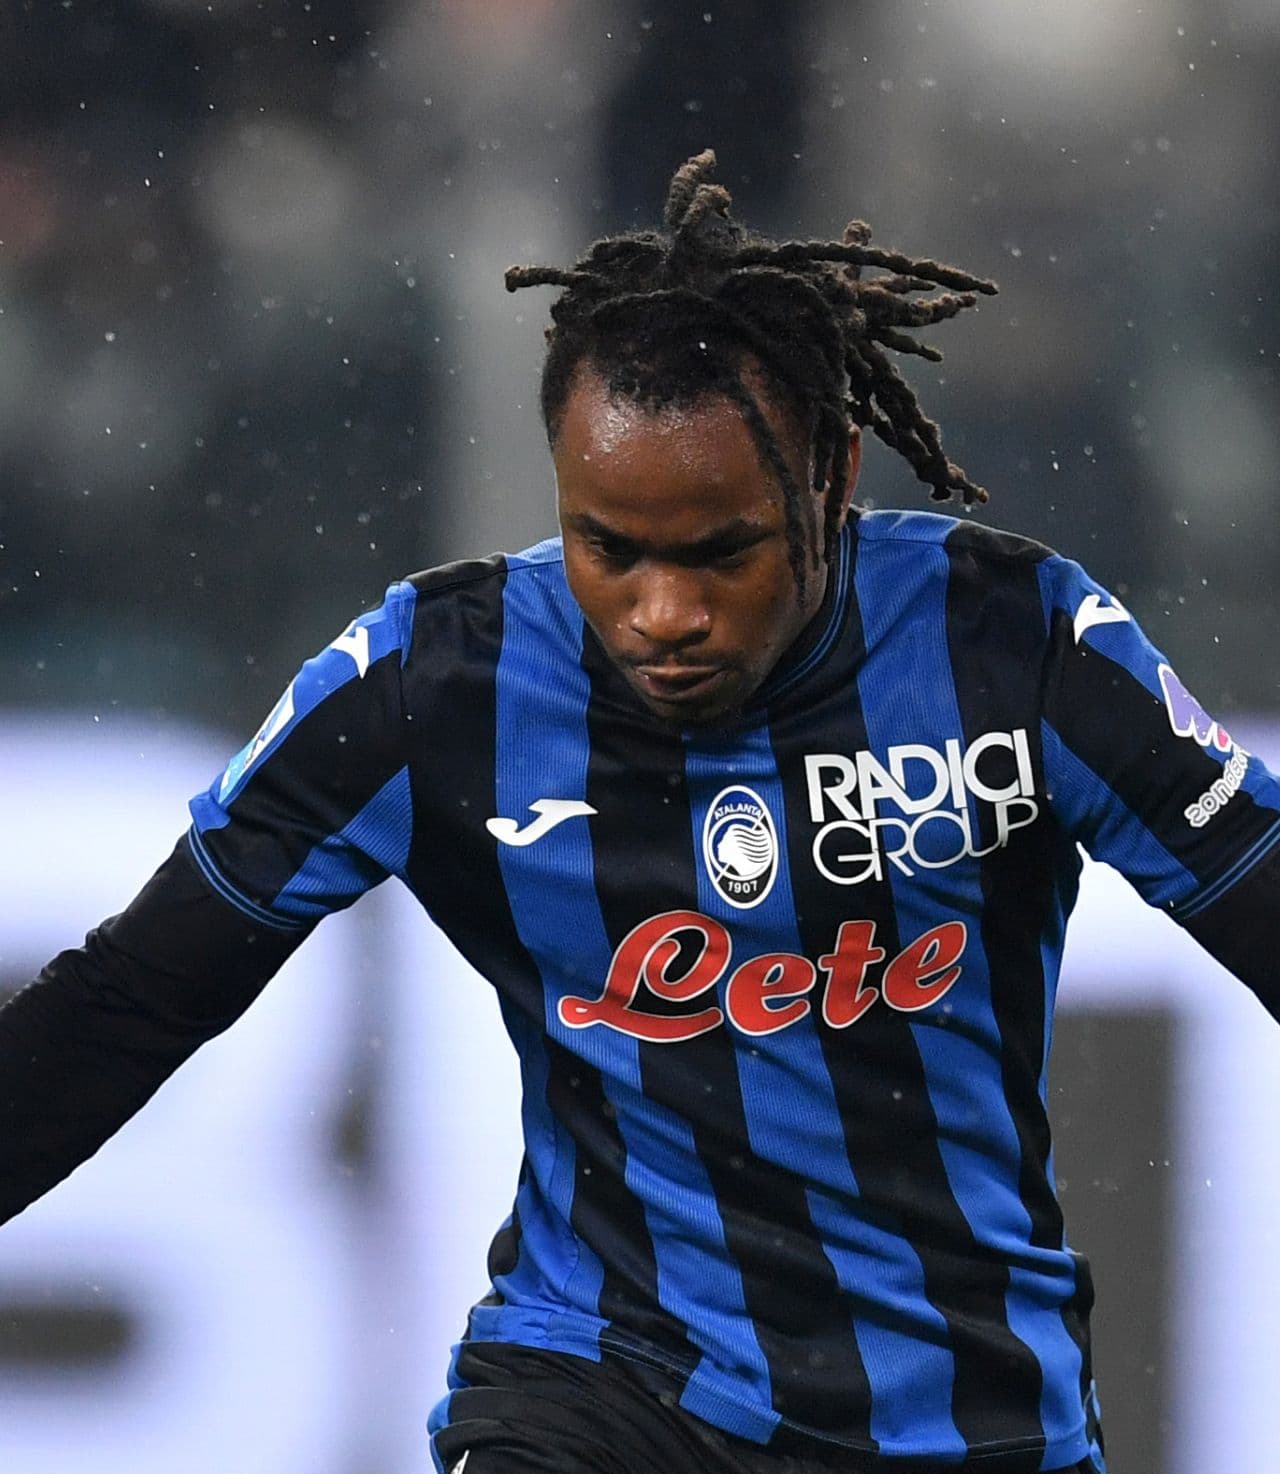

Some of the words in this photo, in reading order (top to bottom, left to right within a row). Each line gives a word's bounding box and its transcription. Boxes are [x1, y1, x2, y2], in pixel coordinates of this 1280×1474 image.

[714, 803, 763, 820] ATALANTA
[804, 729, 1035, 822] RADICI
[812, 798, 1039, 885] GROUP
[728, 881, 758, 894] 1907
[558, 910, 967, 1043] Lete
